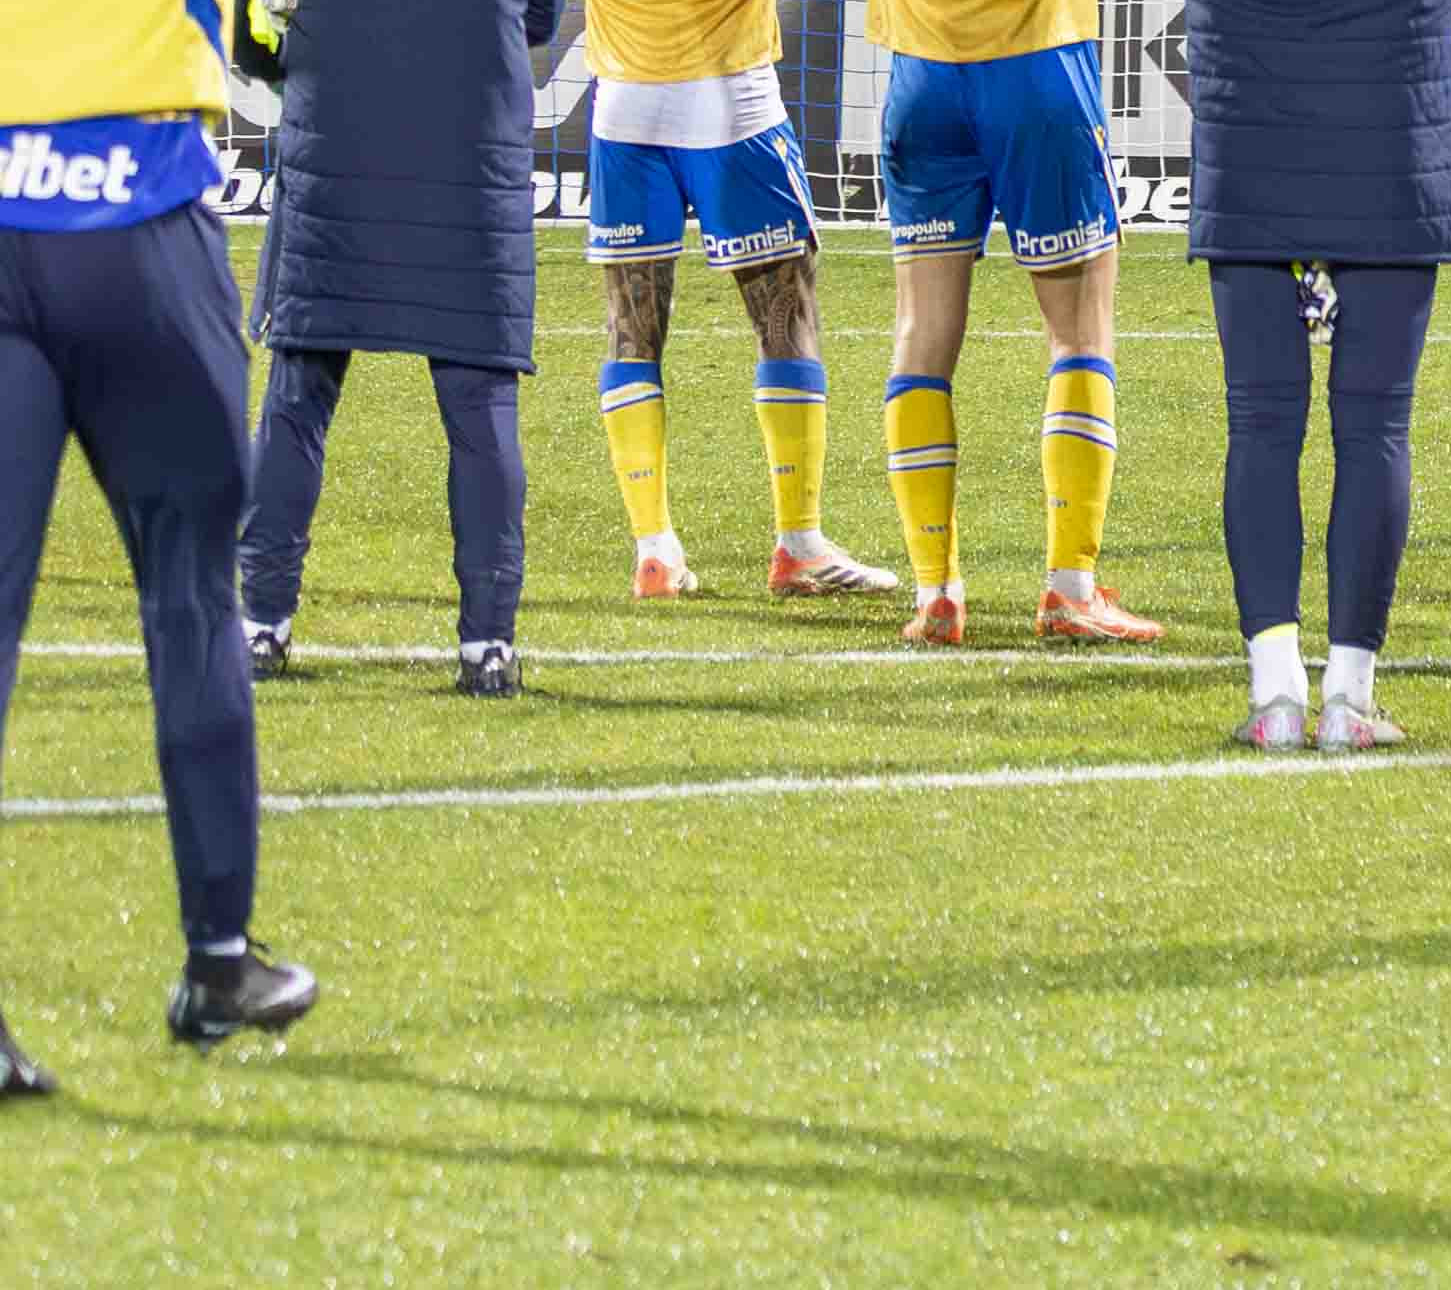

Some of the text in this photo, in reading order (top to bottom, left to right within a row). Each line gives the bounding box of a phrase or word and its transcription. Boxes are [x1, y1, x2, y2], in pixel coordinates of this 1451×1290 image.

[0, 131, 140, 204] ibet
[703, 220, 796, 258] Promist
[1015, 214, 1109, 256] Promist
